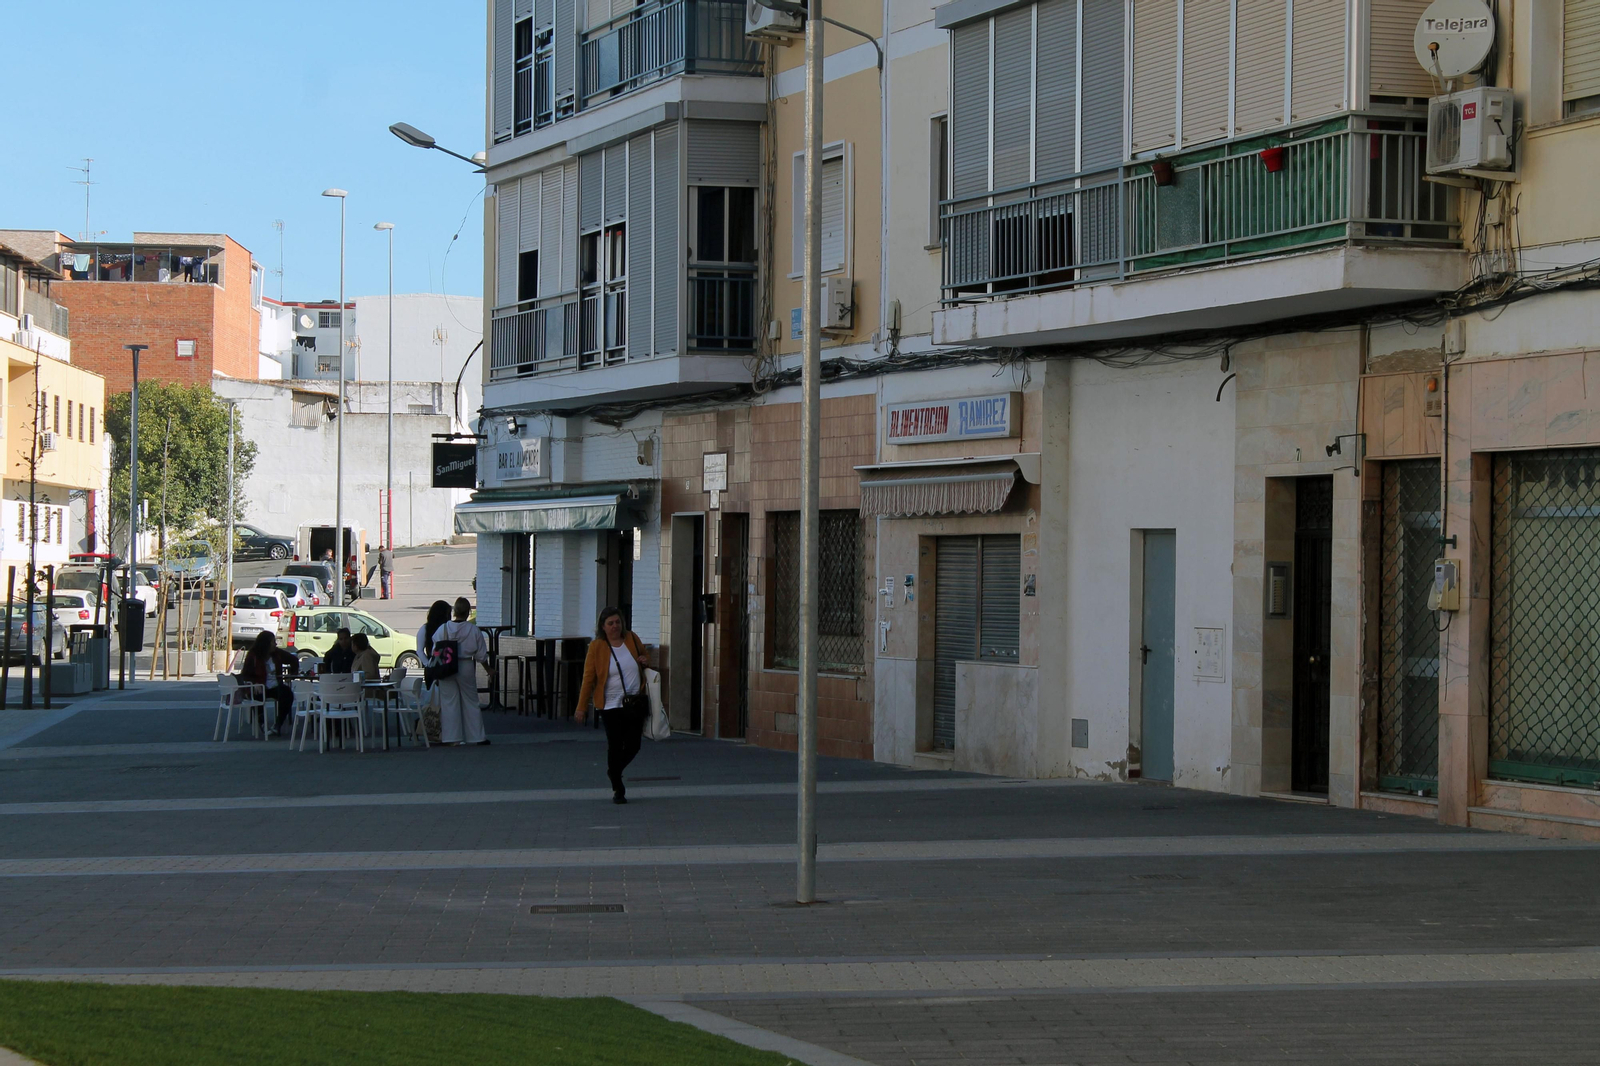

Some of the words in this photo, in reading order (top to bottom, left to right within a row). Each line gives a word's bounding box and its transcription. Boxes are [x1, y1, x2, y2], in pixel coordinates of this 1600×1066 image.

[1425, 17, 1488, 33] Telejara
[1464, 107, 1475, 116] TCL
[889, 405, 950, 438] ALIMENTACION
[958, 397, 1007, 435] RAMIREZ
[498, 452, 508, 470] BAR
[509, 452, 515, 468] EL
[1296, 448, 1300, 461] 7
[494, 512, 507, 532] BAR
[523, 511, 530, 531] EL
